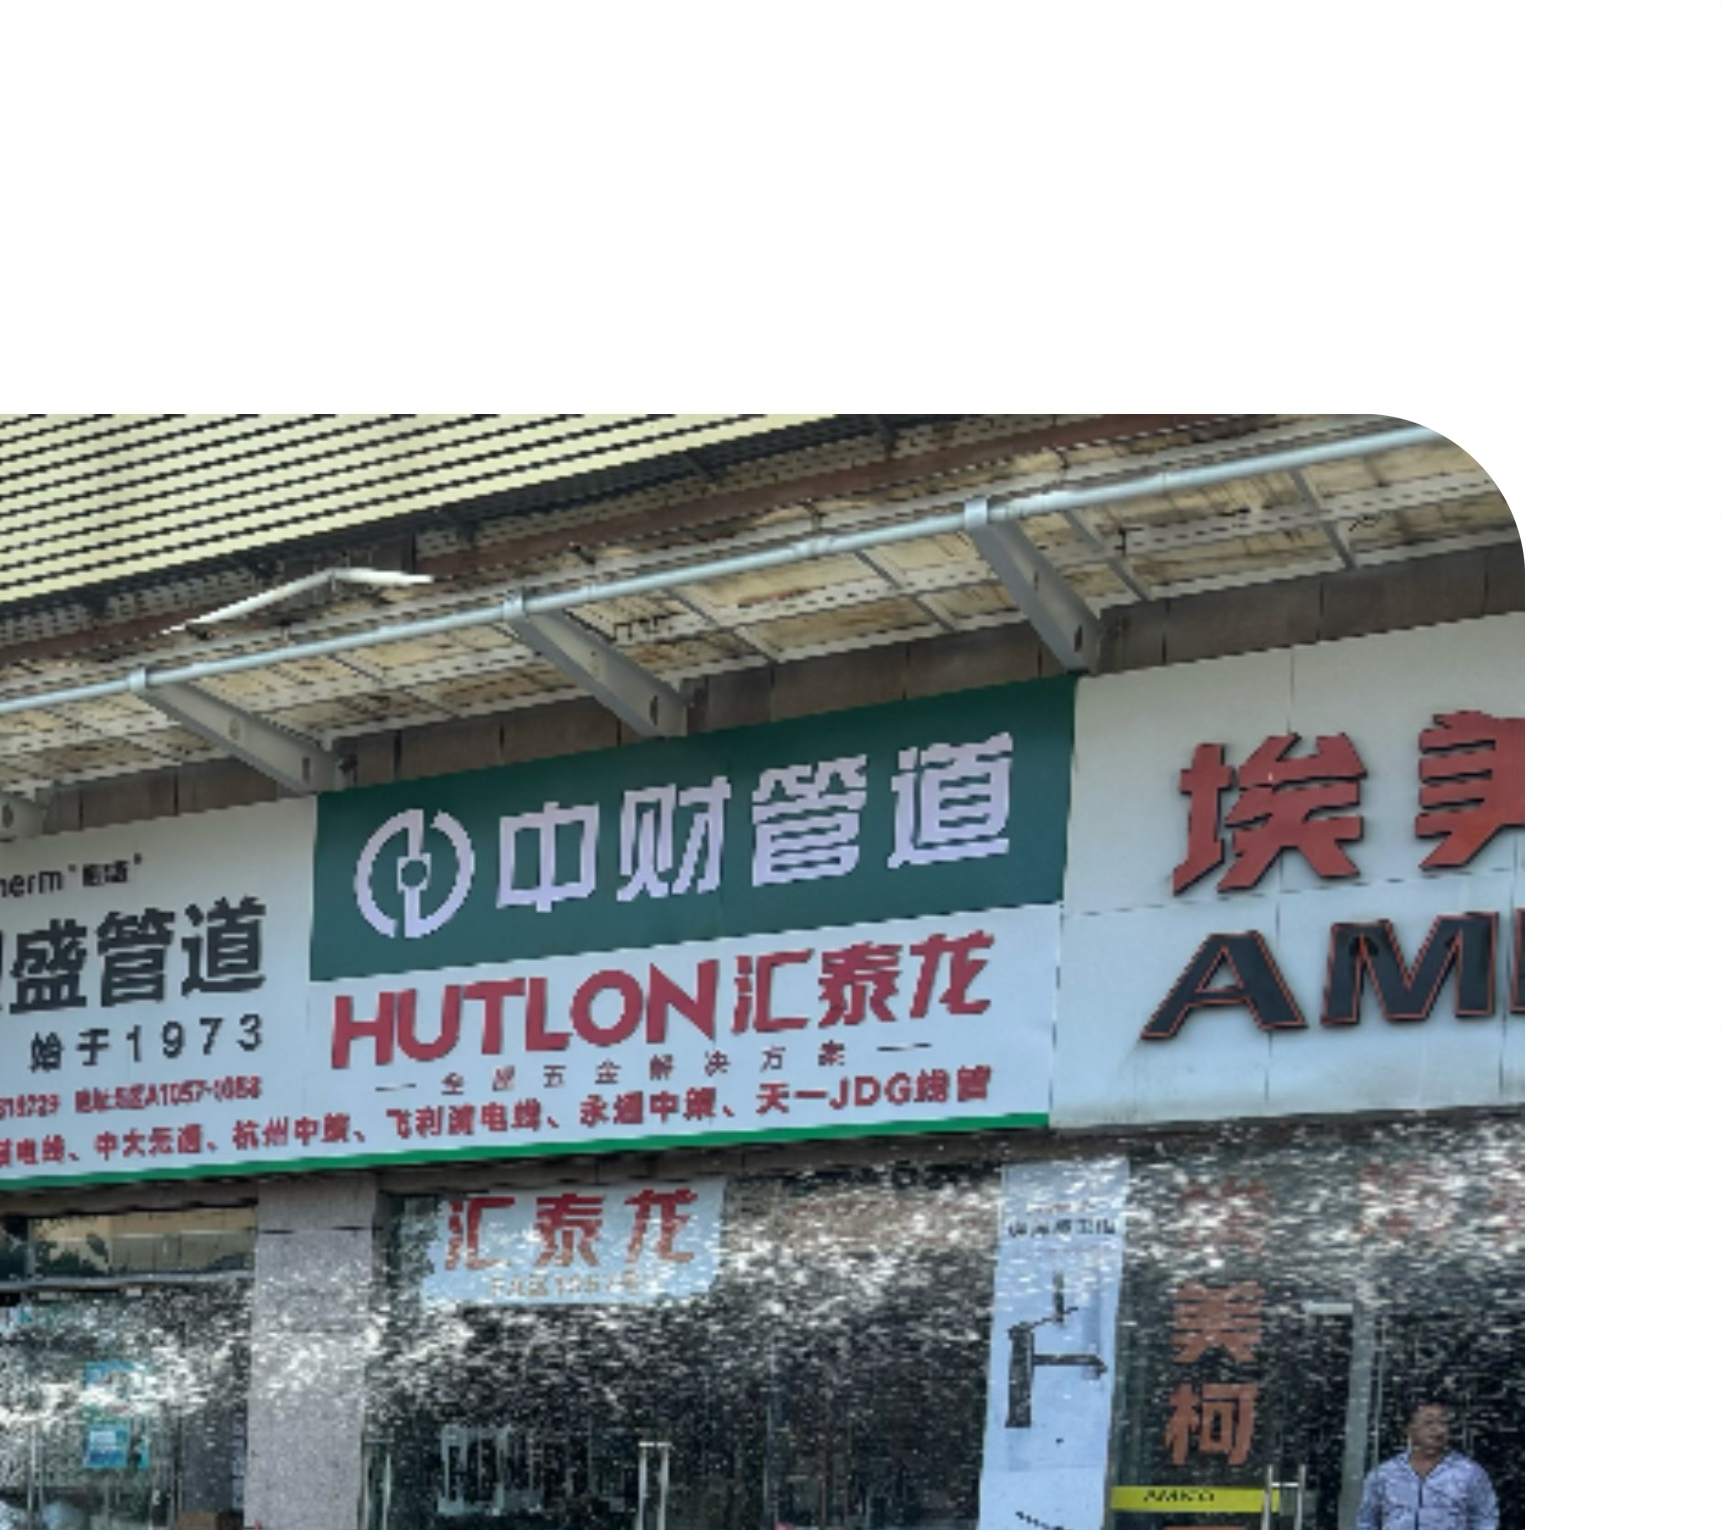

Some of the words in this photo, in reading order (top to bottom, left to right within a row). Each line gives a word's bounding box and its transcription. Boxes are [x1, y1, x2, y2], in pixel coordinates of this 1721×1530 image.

[496, 731, 1013, 913] 中财管道
[1140, 907, 1525, 1040] AM
[444, 1187, 699, 1272] 汇泰龙
